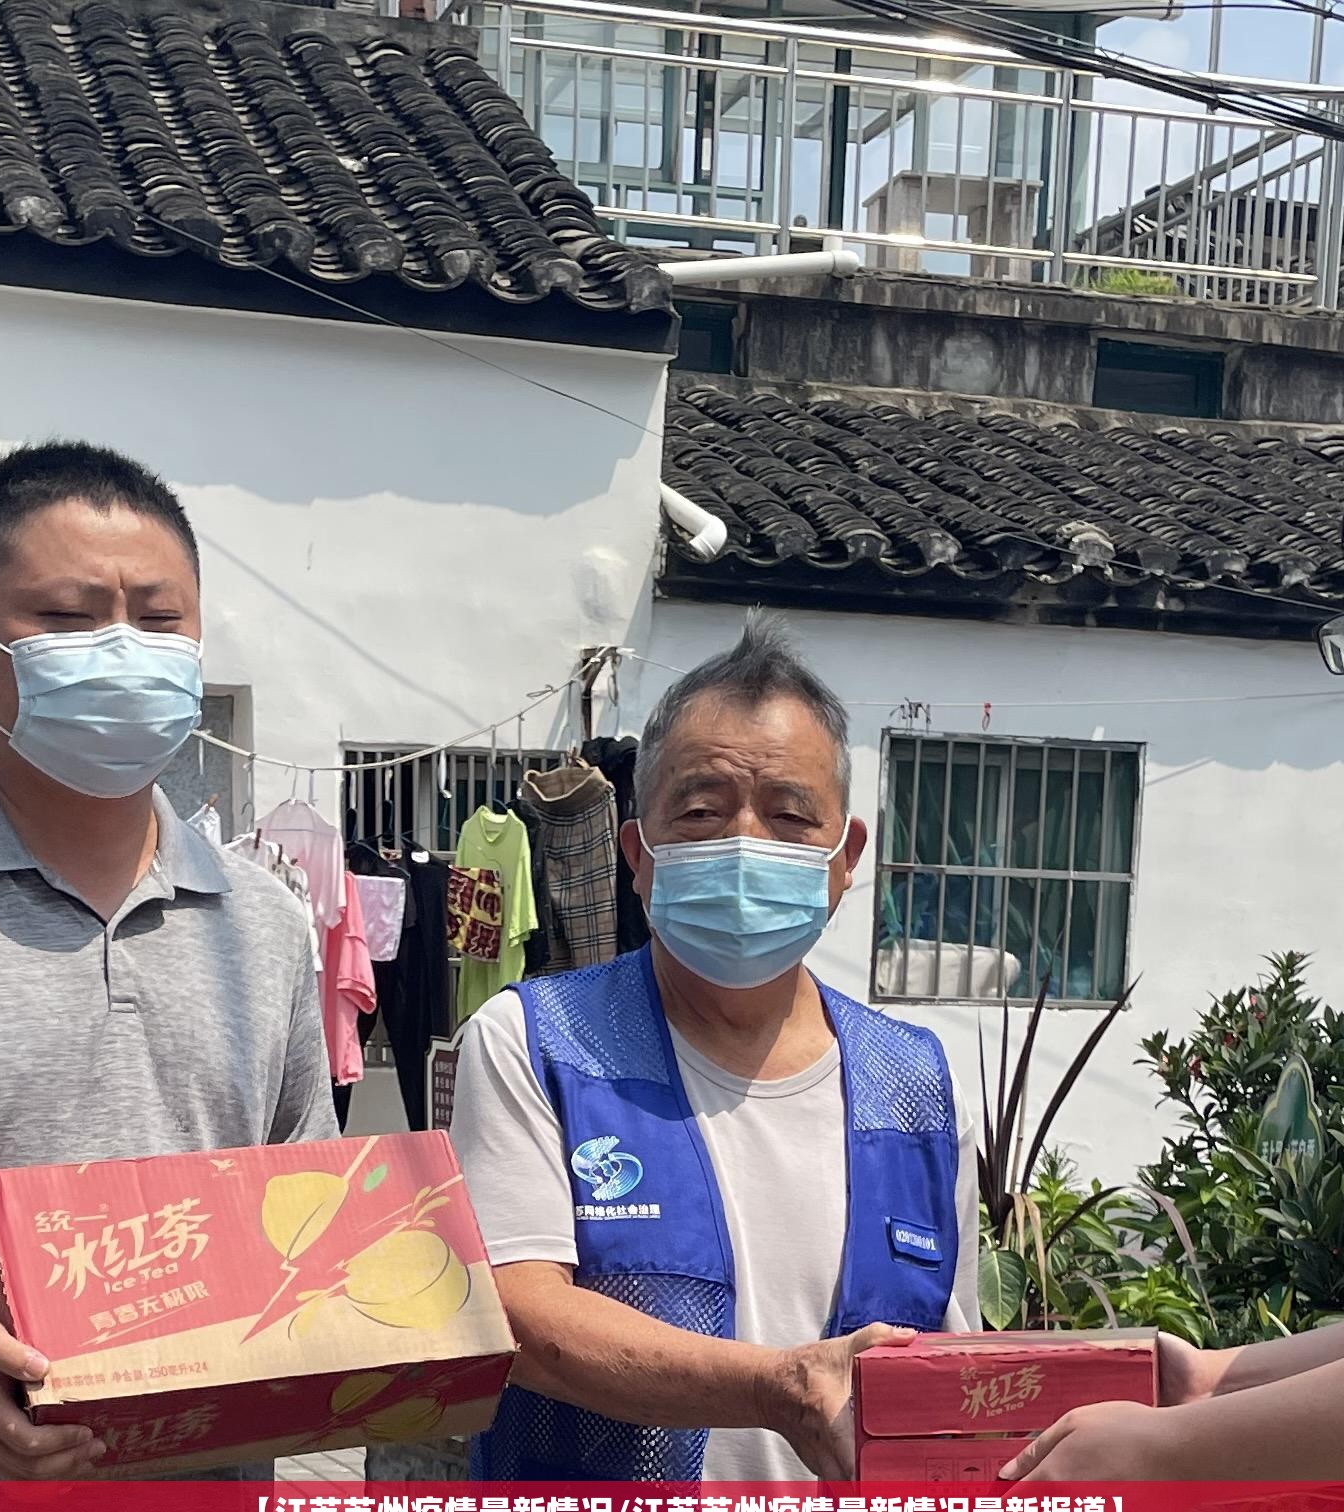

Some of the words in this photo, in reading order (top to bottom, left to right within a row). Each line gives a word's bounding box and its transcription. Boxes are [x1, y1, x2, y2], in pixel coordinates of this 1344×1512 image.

[34, 1209, 108, 1233] 统一
[41, 1197, 213, 1299] 冰红茶
[103, 1277, 137, 1294] Ice
[139, 1262, 179, 1281] Tea
[960, 1364, 1046, 1419] 冰红茶
[986, 1407, 1003, 1418] Ice
[1005, 1401, 1025, 1414] Tea
